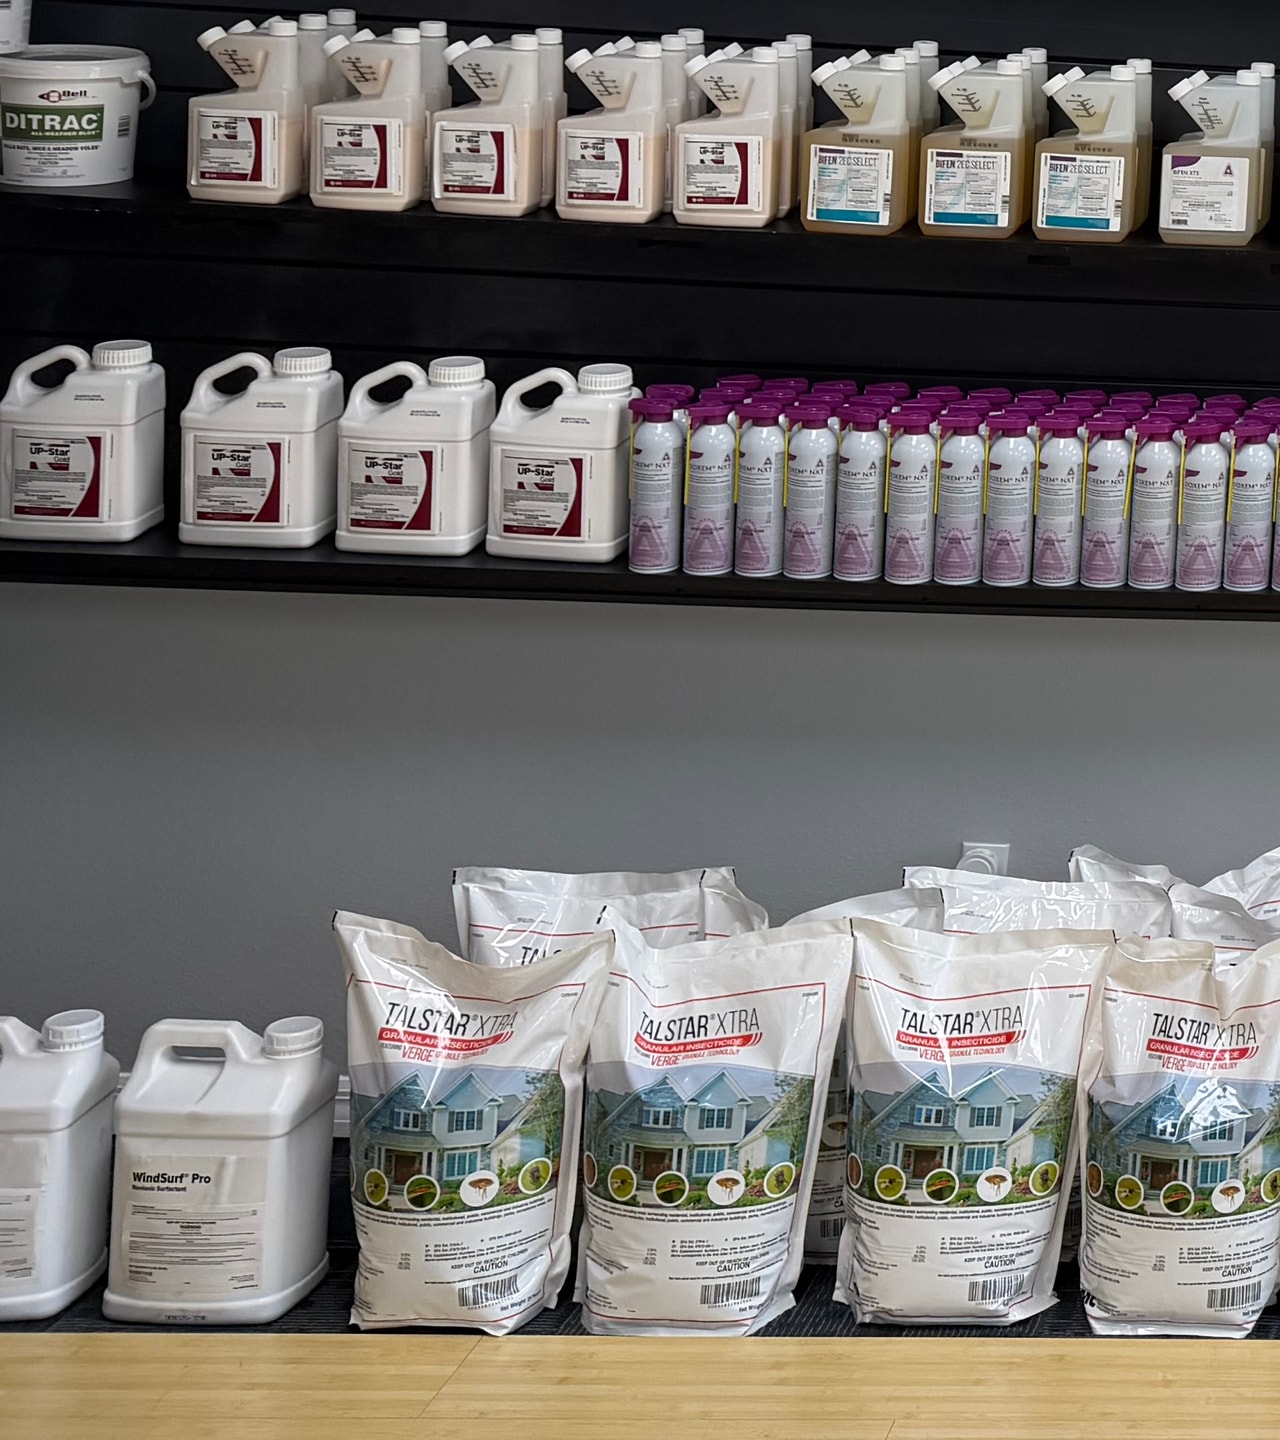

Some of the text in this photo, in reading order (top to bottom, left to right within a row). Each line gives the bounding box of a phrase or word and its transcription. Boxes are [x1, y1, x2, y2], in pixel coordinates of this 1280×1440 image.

[62, 90, 88, 99] Bell
[5, 113, 100, 130] DITRAC
[818, 155, 837, 165] BIFEN
[852, 156, 878, 167] SELECT
[30, 446, 70, 456] UP-Star
[365, 461, 403, 471] UP-Star
[517, 467, 554, 477] UP-Star
[473, 1012, 518, 1037] XTRA
[715, 1008, 760, 1036] XTRA
[980, 1006, 1023, 1032] XTRA
[952, 1035, 1007, 1046] INSECTICIDE
[1214, 1022, 1257, 1047] XTRA
[636, 1038, 743, 1052] GRANULAR INSECTICIDE
[1150, 1041, 1189, 1055] GRANULAR
[401, 1045, 435, 1062] VERGE
[650, 1054, 681, 1067] VERGE
[1161, 1055, 1186, 1071] VERGE
[191, 1173, 212, 1184] Pro
[473, 1259, 509, 1275] CAUTION
[716, 1262, 751, 1273] CAUTION
[984, 1259, 1016, 1270] CAUTION
